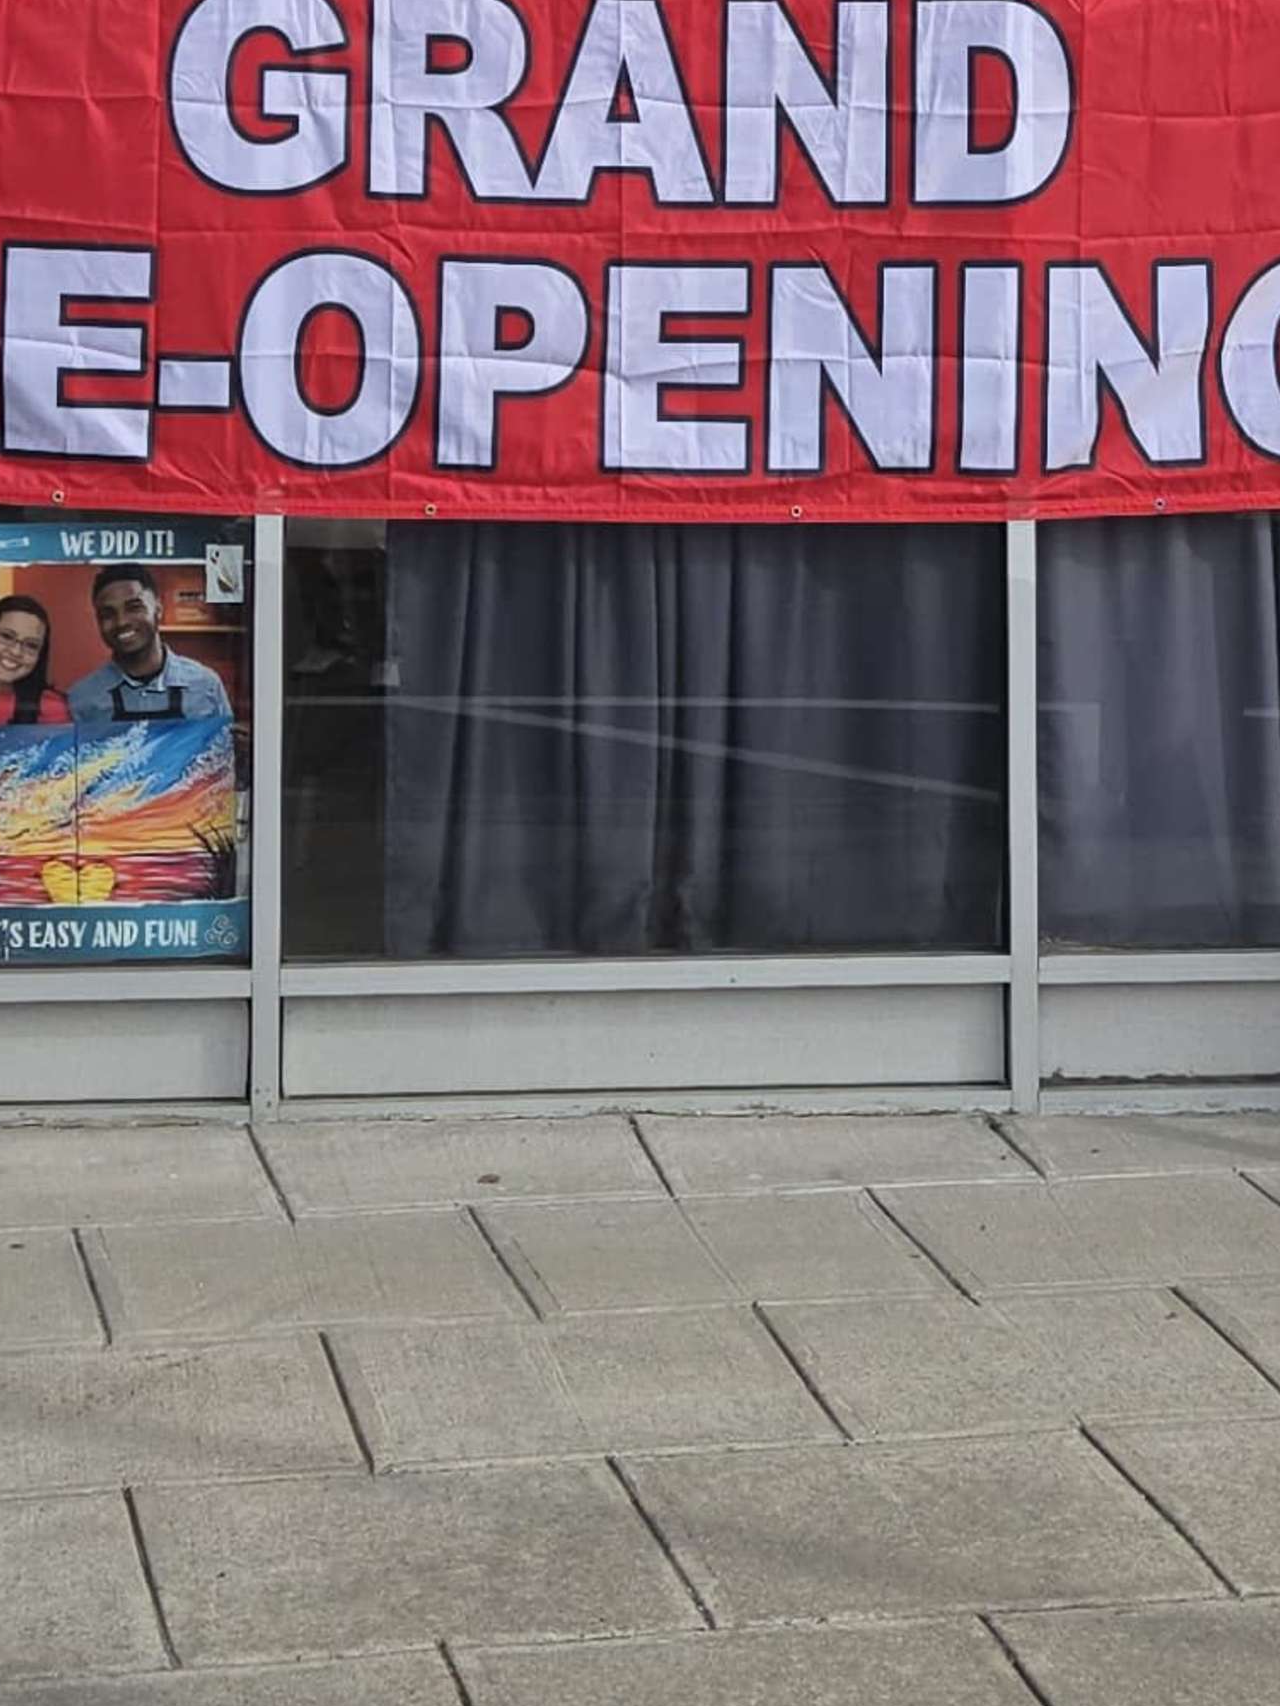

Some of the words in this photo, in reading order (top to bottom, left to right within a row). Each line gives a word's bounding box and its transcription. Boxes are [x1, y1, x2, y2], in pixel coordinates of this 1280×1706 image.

[60, 530, 96, 557] WE
[100, 530, 138, 556] DID
[145, 530, 175, 556] IT!
[29, 921, 87, 949] EASY
[92, 919, 139, 948] AND
[144, 918, 198, 947] FUN!
